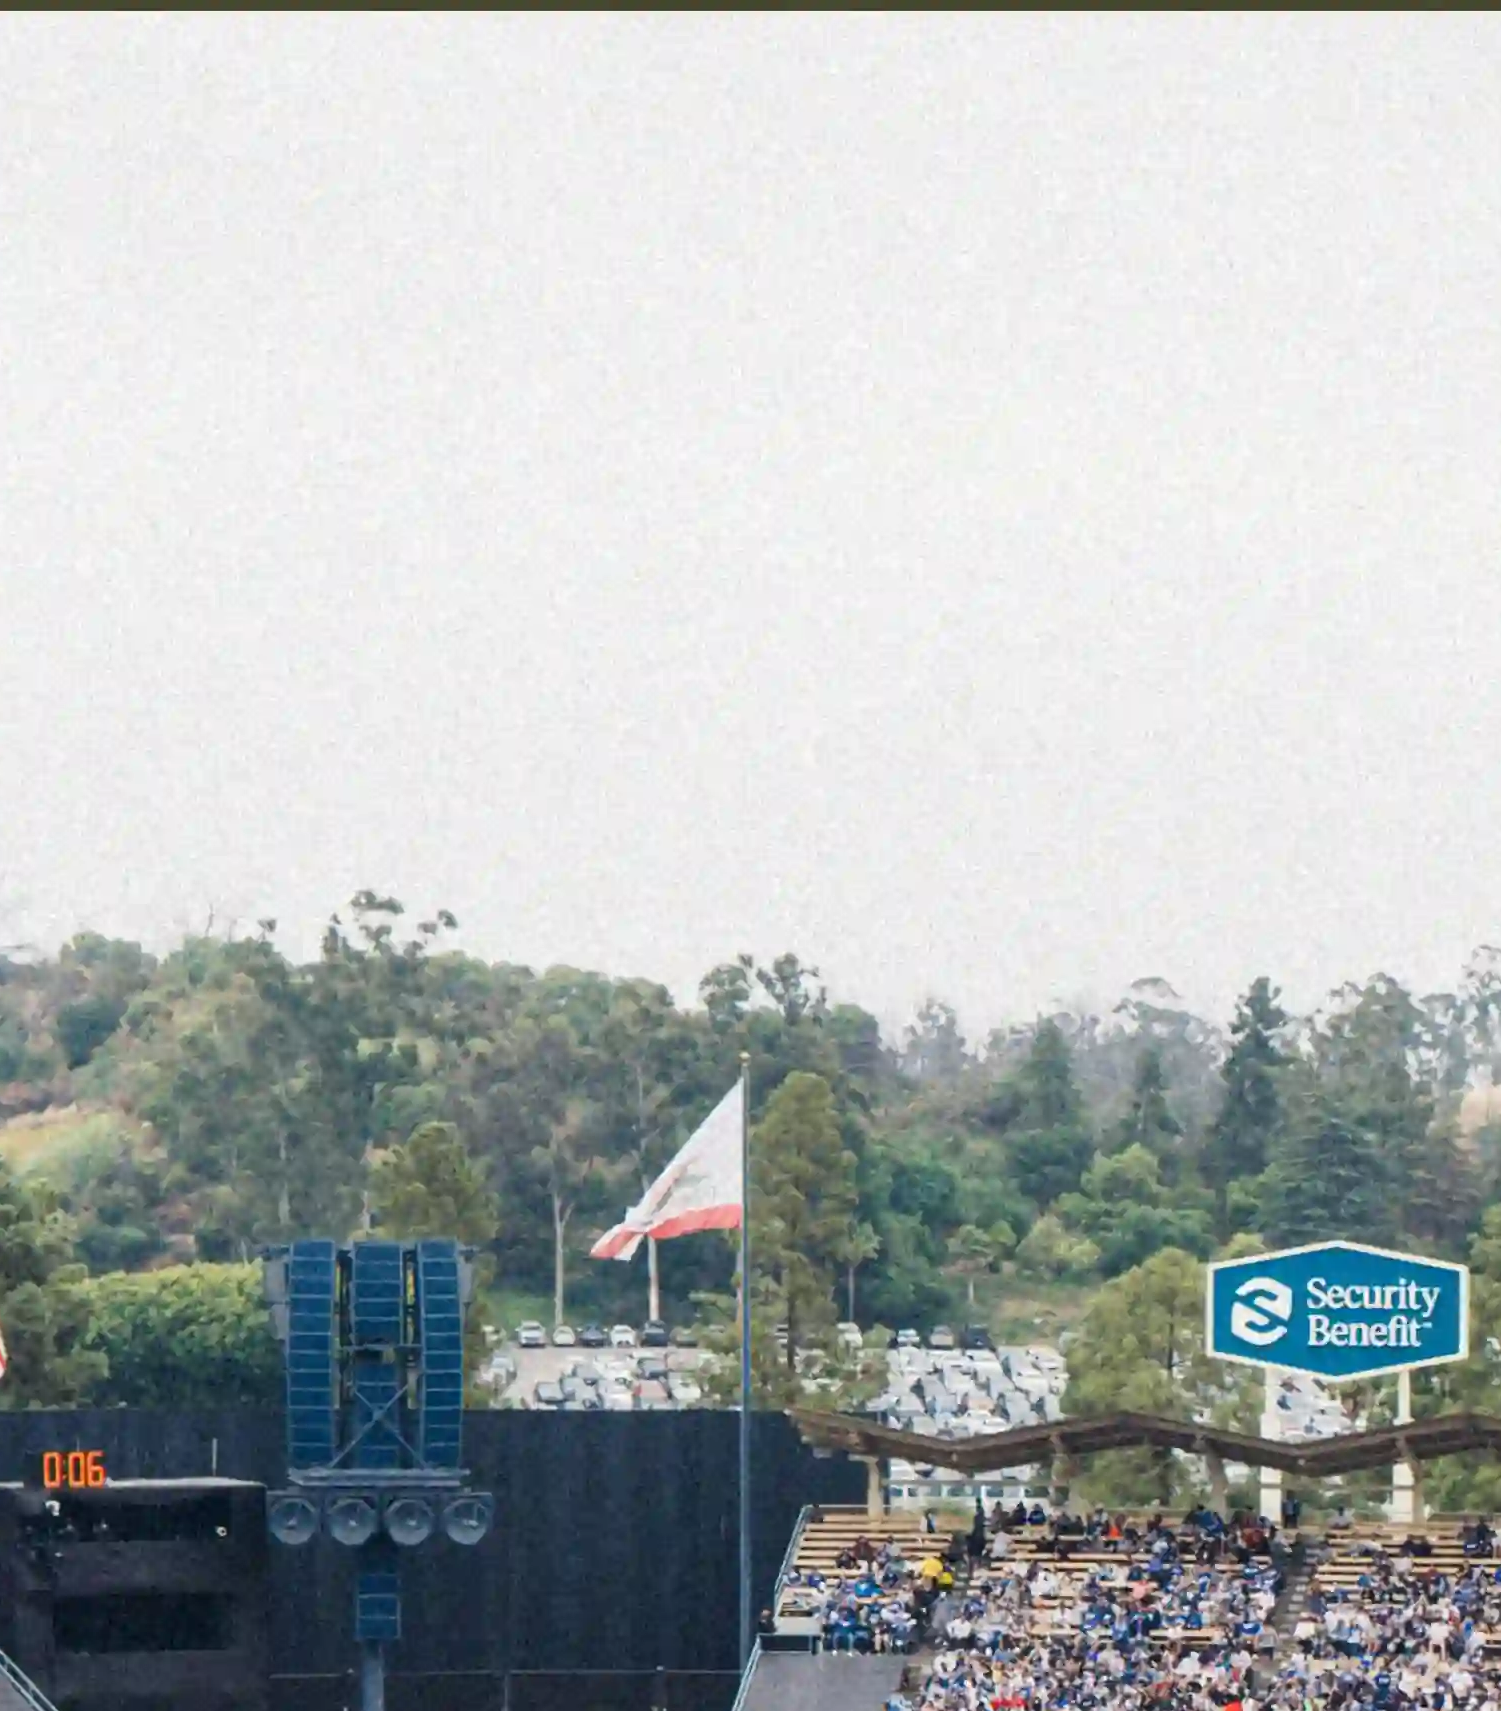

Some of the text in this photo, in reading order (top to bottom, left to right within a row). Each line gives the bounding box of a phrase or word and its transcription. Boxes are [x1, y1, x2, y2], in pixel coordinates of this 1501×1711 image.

[1307, 1277, 1441, 1318] Security
[1307, 1314, 1422, 1348] Benefit
[43, 1452, 106, 1488] 0:06
